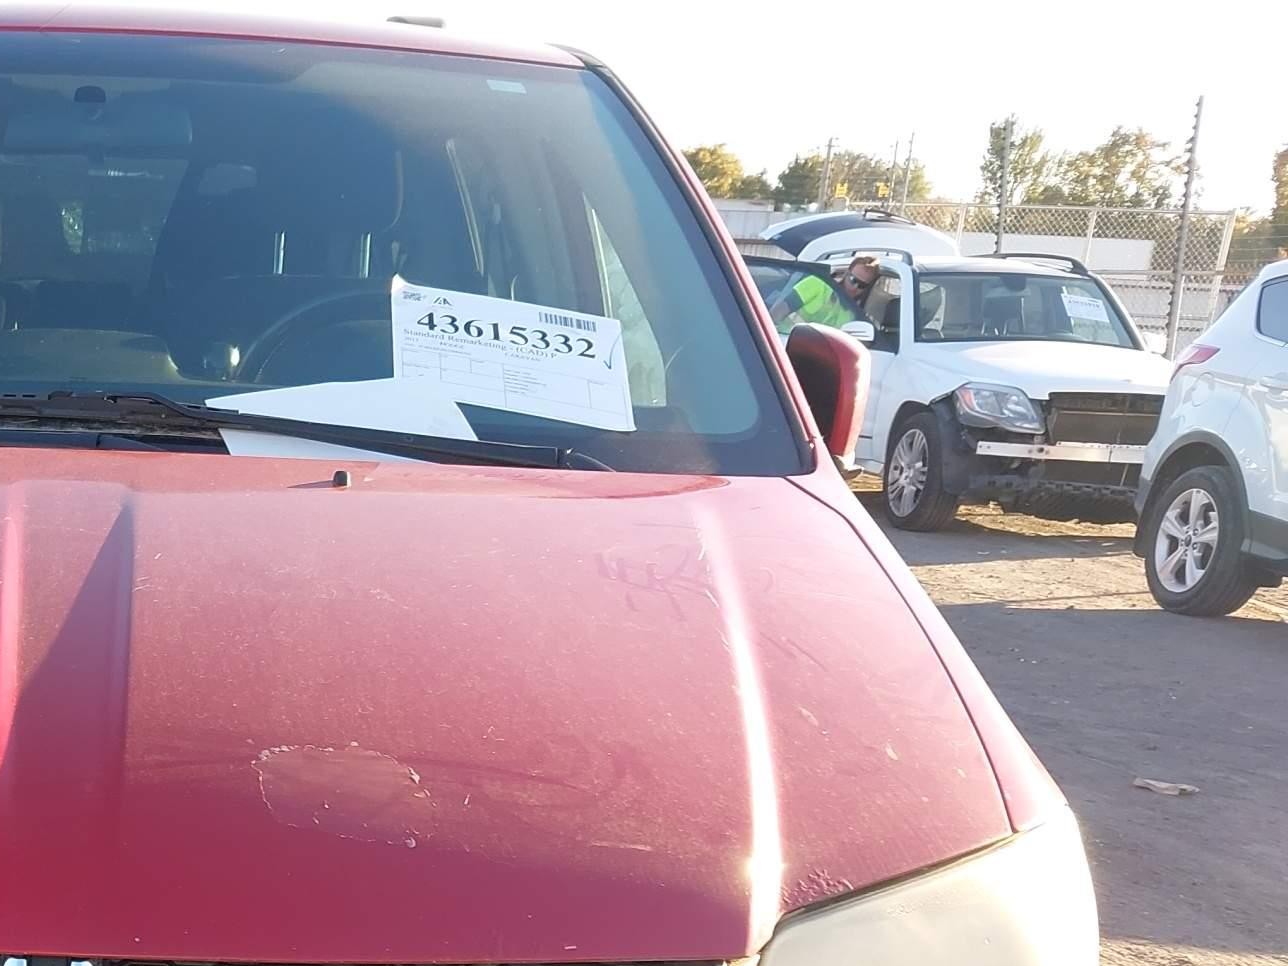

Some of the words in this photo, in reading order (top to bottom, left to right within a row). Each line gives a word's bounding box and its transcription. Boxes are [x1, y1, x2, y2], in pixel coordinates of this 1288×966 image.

[403, 328, 445, 341] Standard
[448, 335, 508, 352] Remarketing
[416, 311, 596, 359] 43615332
